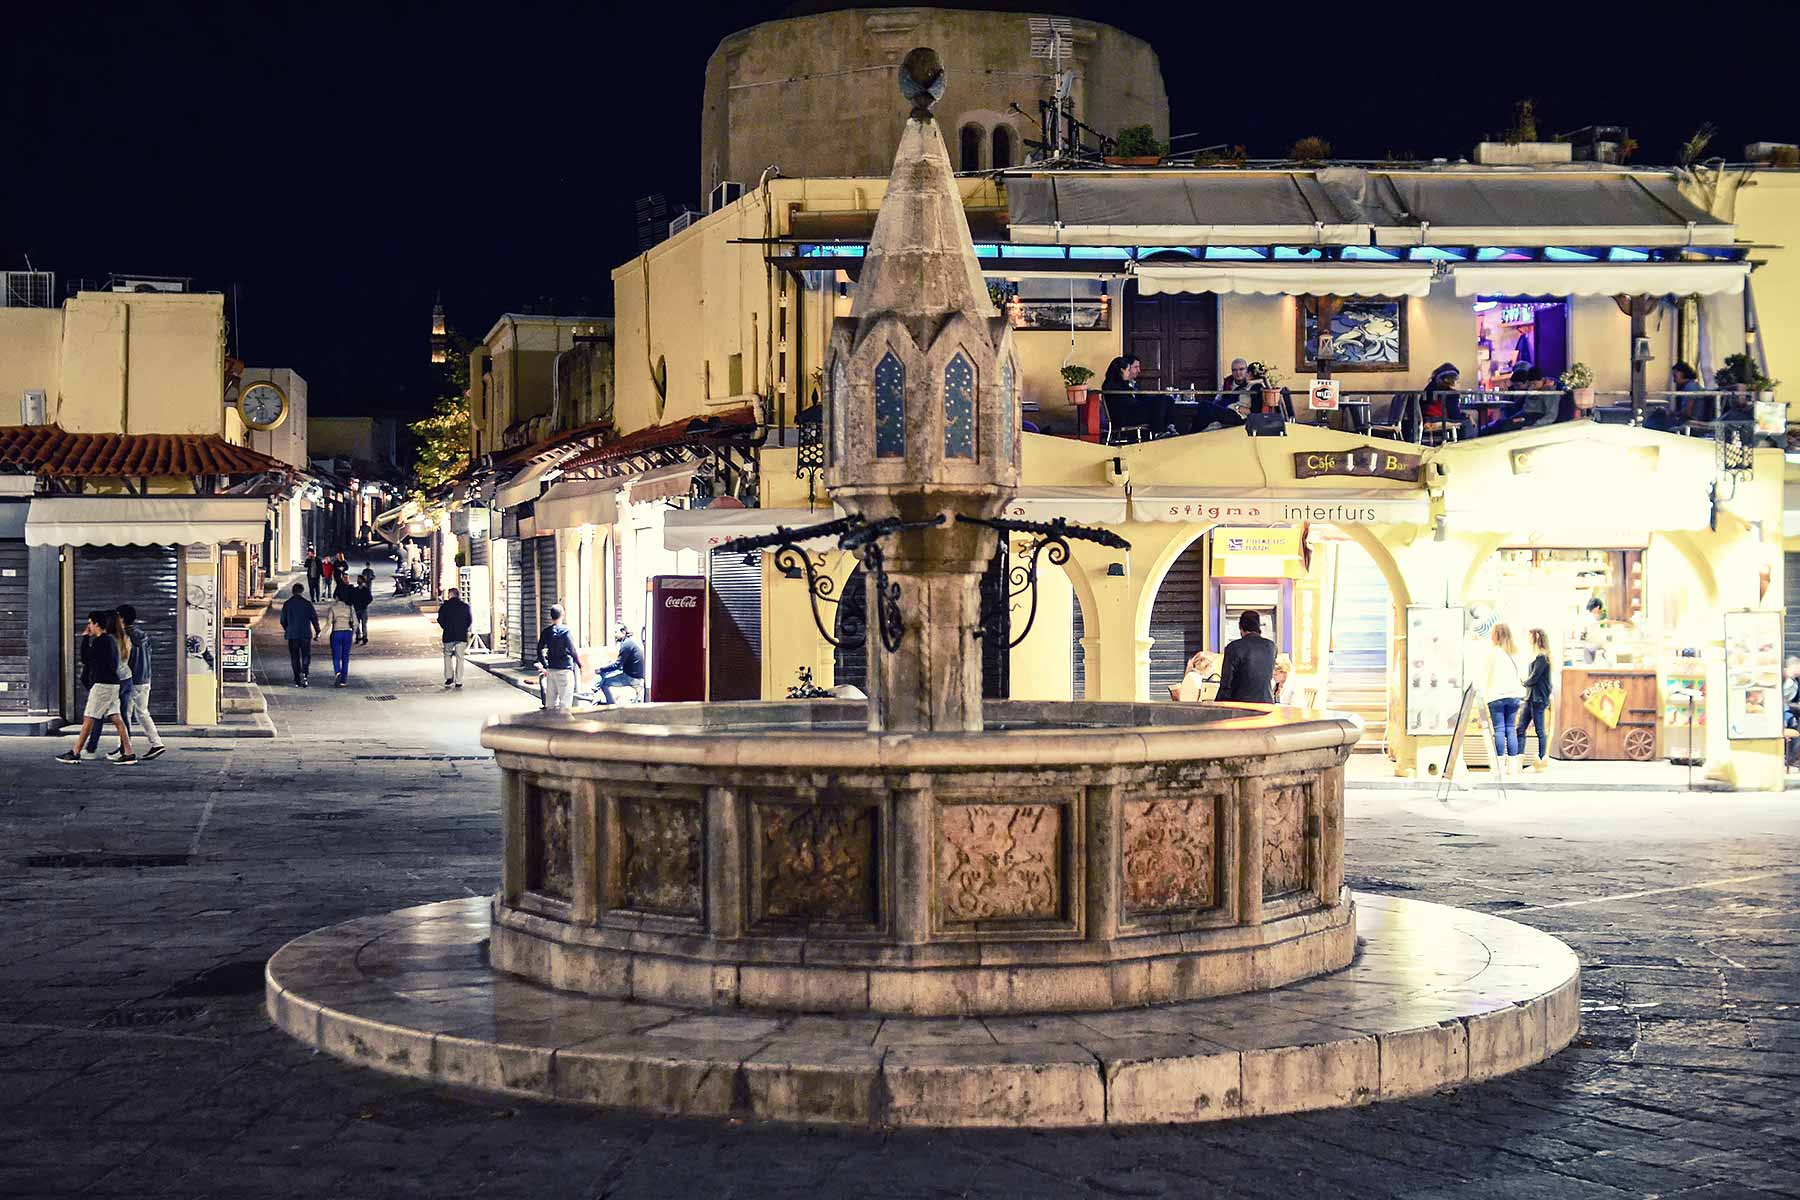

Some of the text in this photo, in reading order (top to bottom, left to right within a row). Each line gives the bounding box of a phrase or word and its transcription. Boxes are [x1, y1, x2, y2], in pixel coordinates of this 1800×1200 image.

[1307, 454, 1336, 472] Café
[1169, 504, 1376, 521] stigma interfurs
